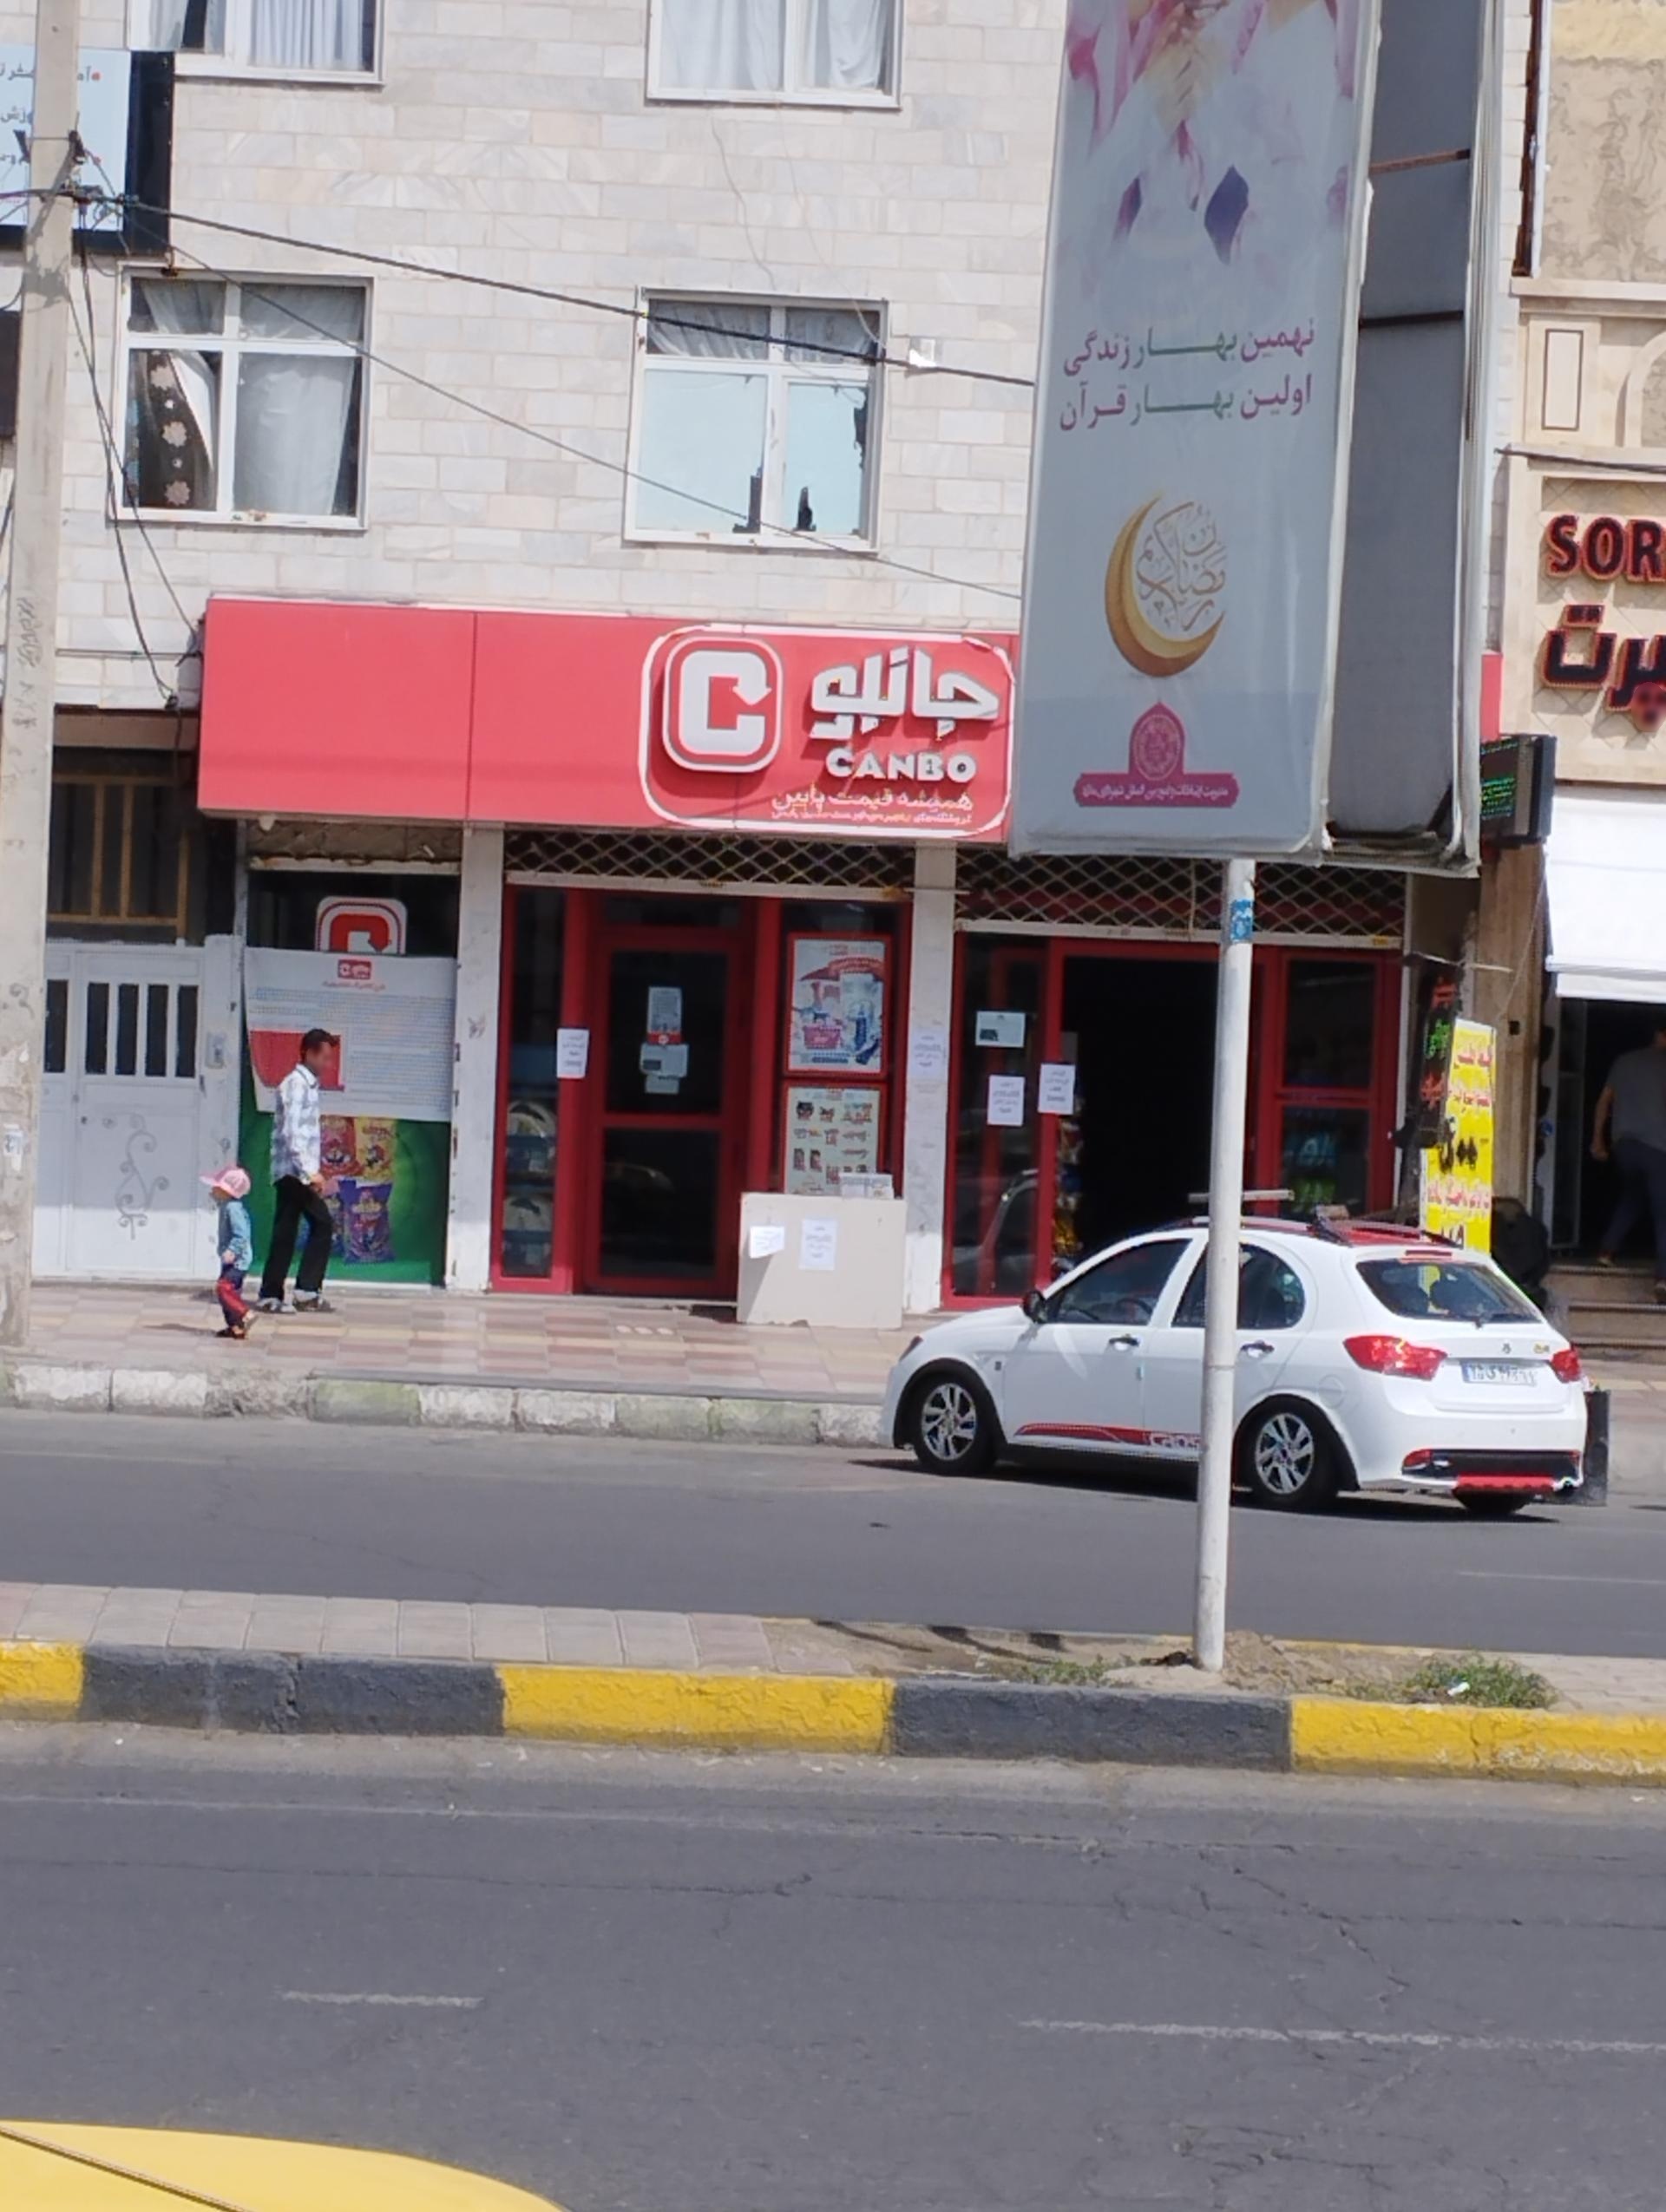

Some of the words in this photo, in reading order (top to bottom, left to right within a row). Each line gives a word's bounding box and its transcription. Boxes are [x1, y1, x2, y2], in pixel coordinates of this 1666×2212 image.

[1063, 330, 1131, 376] زندگی
[1240, 317, 1315, 363] نهمین
[1059, 381, 1127, 431] قرآن
[1240, 373, 1313, 420] اولین
[1545, 514, 1666, 583] SOR
[809, 645, 1000, 741] جانبو
[825, 747, 979, 783] CANBO
[828, 787, 894, 810] قیمت
[896, 788, 974, 813] همیشه
